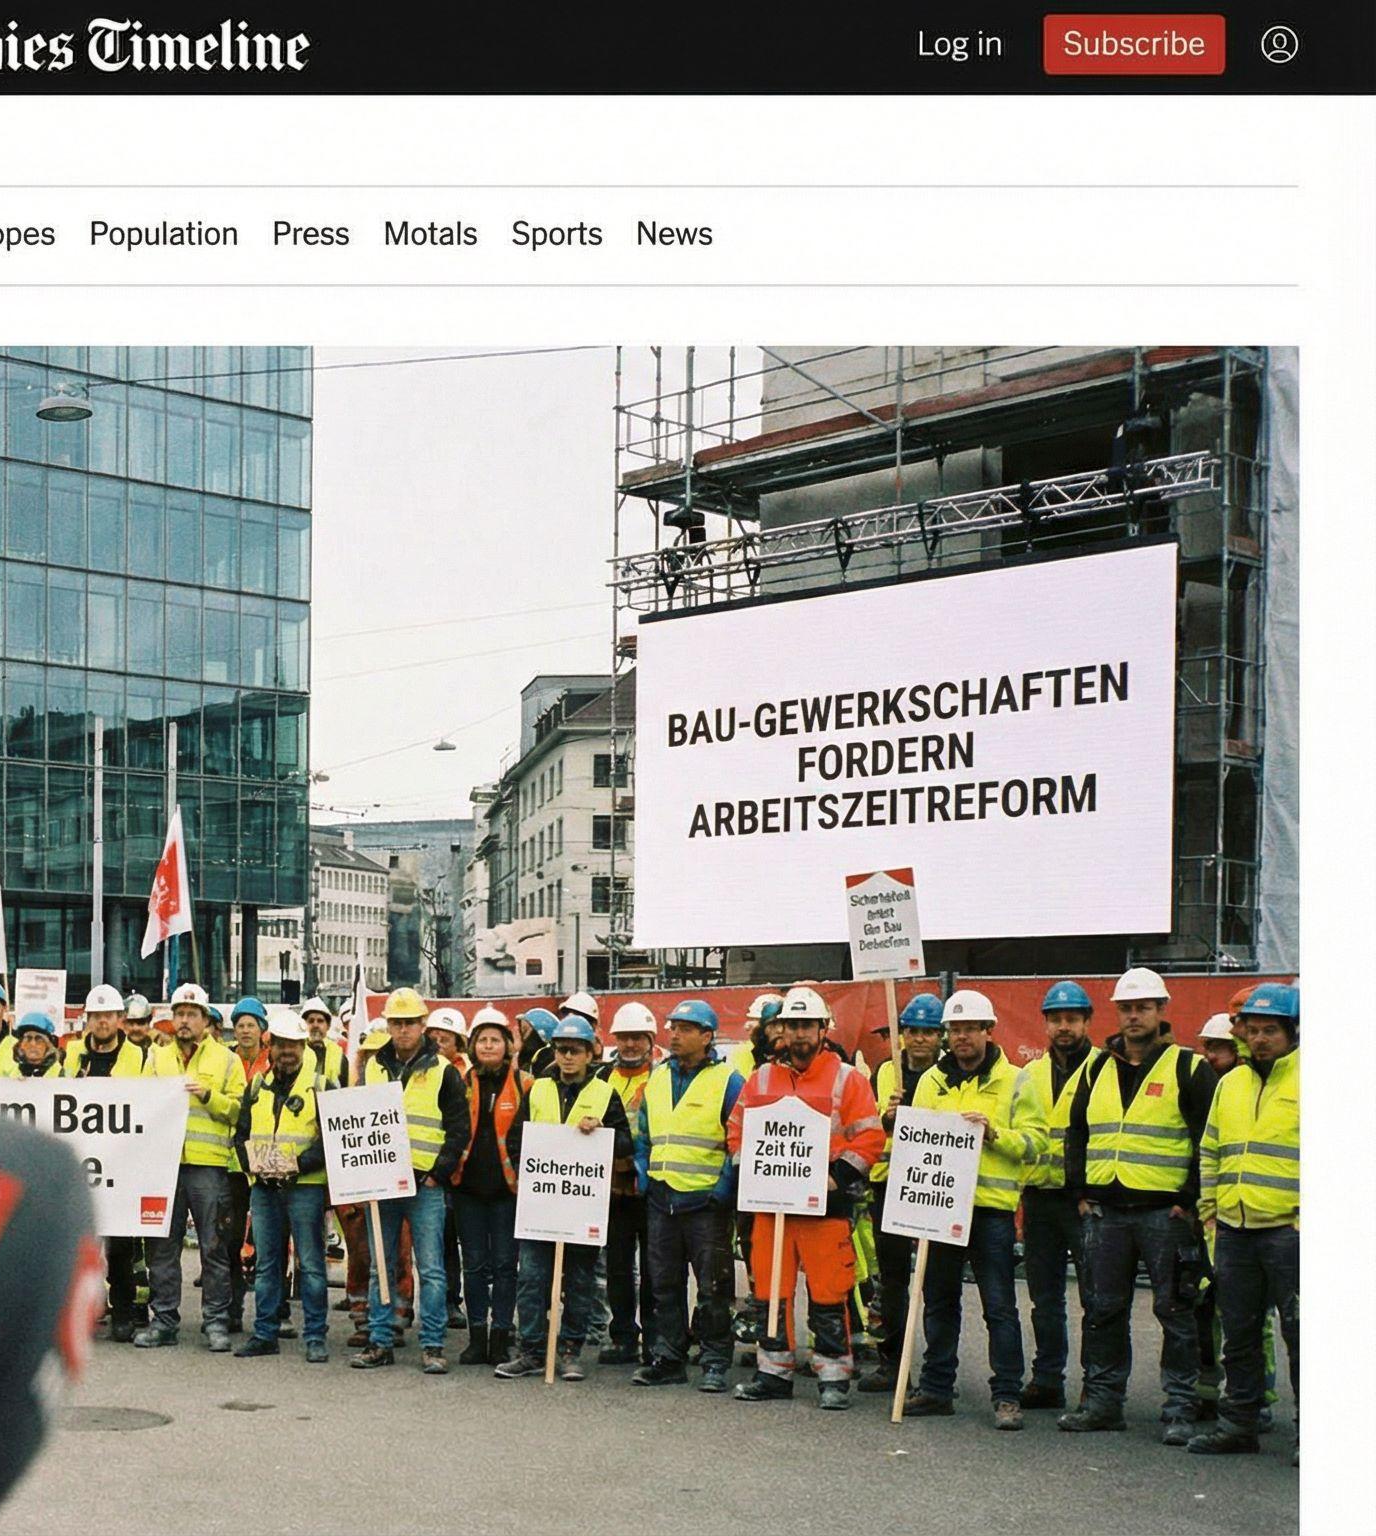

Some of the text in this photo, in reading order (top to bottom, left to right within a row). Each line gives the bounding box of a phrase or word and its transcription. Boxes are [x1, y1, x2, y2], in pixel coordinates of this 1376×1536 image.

[668, 661, 1129, 748] BAU-GEWERKSCHAFTEN
[797, 731, 975, 783] FORDERN
[688, 773, 1098, 839] ARBEITSZEITREFORM
[53, 1094, 144, 1134] Bau.
[327, 1109, 400, 1132] Mehr Zeit
[341, 1130, 391, 1149] für die
[764, 1121, 805, 1138] Mehr
[899, 1125, 975, 1150] Sicherheit
[341, 1149, 397, 1168] Familie
[755, 1140, 813, 1158] Zeit für
[525, 1157, 604, 1178] Sicherheit
[753, 1160, 812, 1178] Familie
[906, 1166, 955, 1188] für die
[532, 1180, 596, 1197] am Bau.
[899, 1185, 954, 1209] Familie
